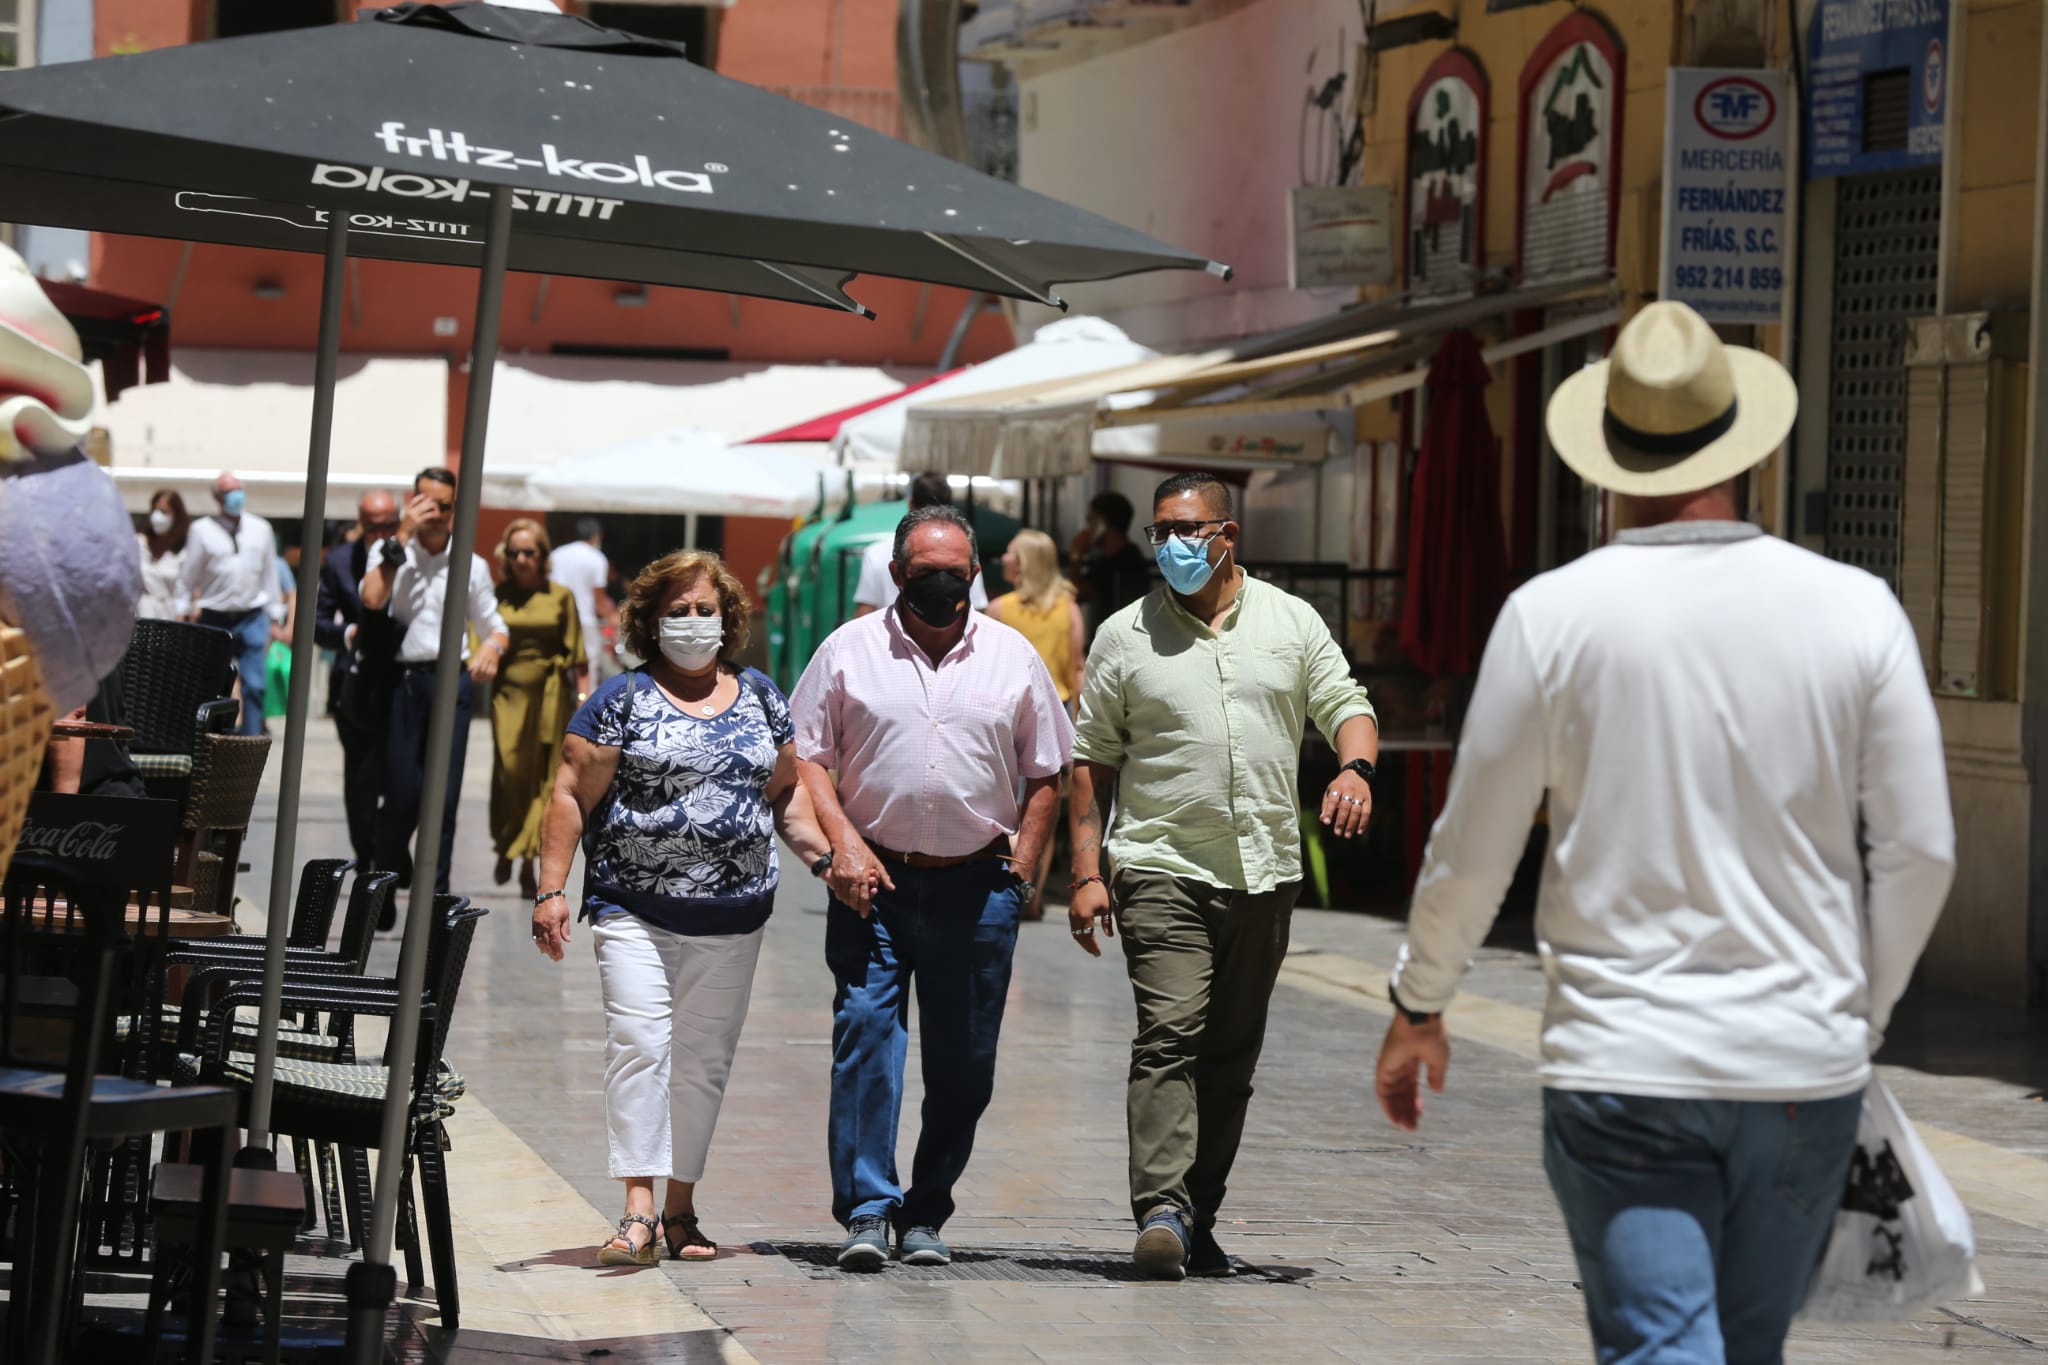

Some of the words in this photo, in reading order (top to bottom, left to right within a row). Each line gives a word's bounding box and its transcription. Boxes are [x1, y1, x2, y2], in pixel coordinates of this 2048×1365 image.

[1681, 144, 1785, 172] MERCERÍA
[1679, 179, 1785, 213] FERNÁNDEZ
[1682, 218, 1741, 256] FRÍAS,
[1744, 227, 1778, 253] S.C.
[1676, 265, 1708, 288] 952
[1712, 266, 1745, 289] 214
[1749, 266, 1783, 290] 859
